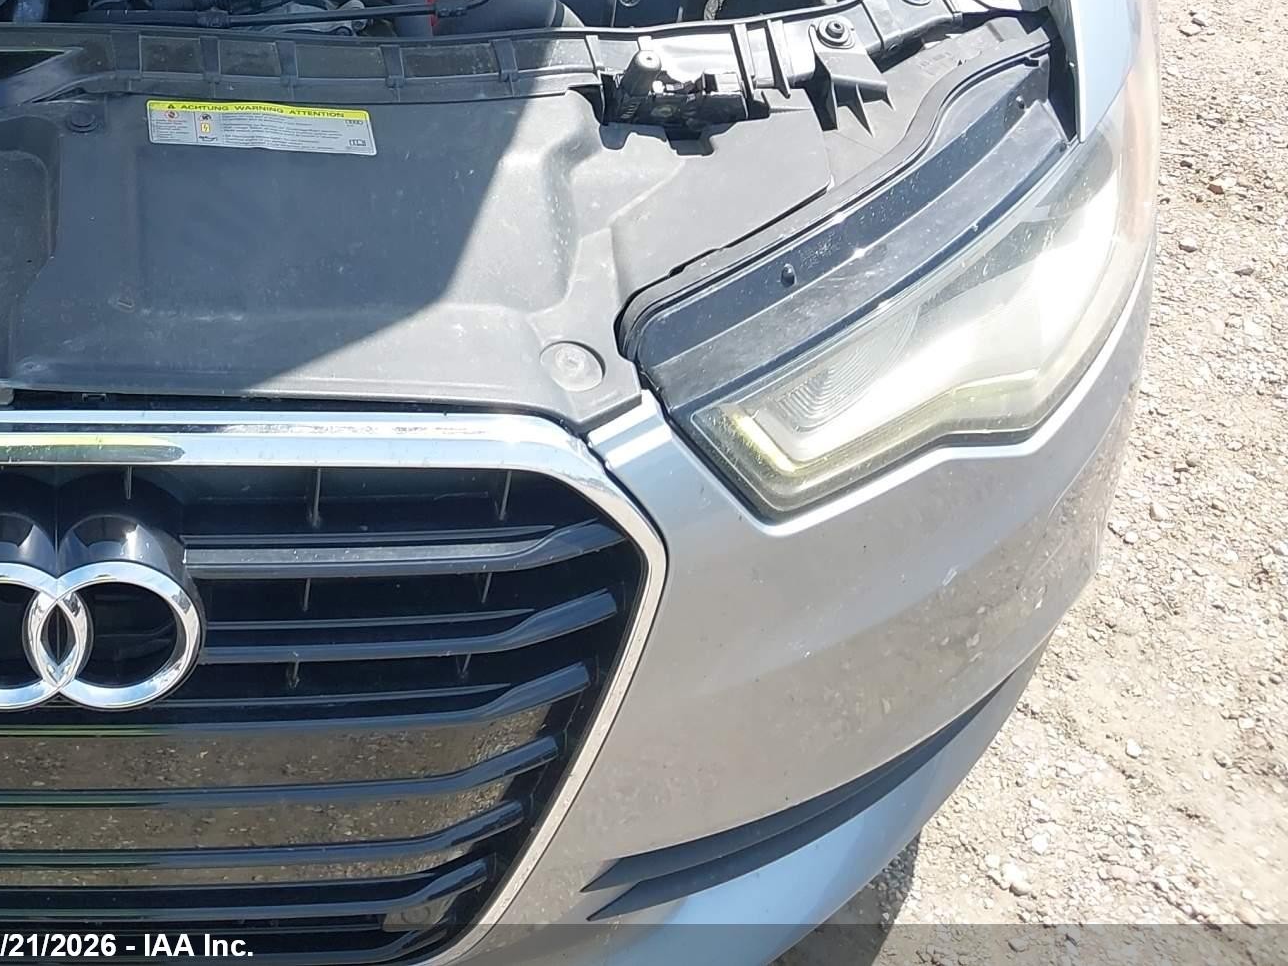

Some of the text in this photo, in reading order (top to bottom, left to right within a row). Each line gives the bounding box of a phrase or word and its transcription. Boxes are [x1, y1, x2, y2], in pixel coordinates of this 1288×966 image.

[180, 103, 345, 118] ACHTUNG WARNING ATTENTION
